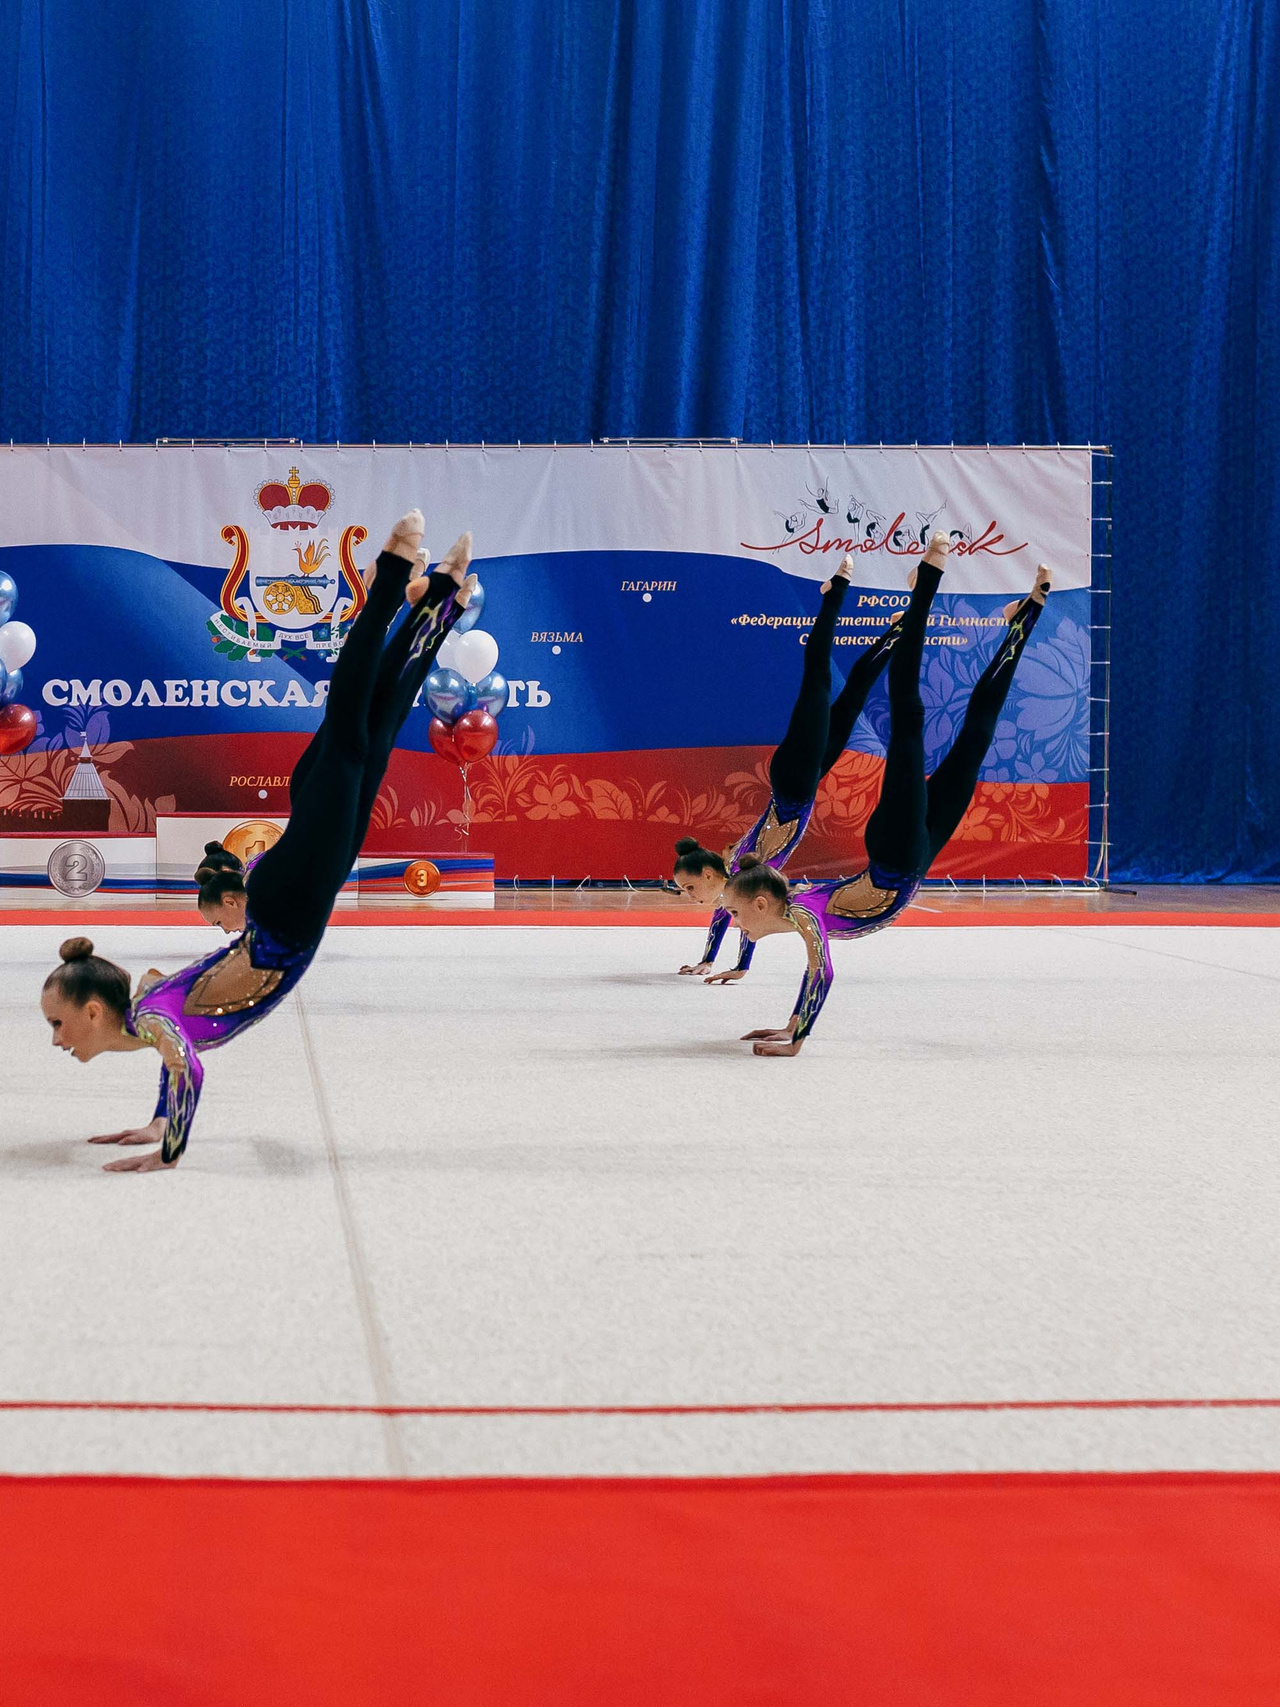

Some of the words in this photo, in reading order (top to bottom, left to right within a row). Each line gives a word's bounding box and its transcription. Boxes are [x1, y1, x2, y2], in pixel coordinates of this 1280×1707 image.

[740, 512, 1029, 557] Smolesk
[620, 580, 677, 592] ГАГАРИН
[857, 595, 911, 607] РФСОО
[939, 614, 1036, 627] Гимнаст
[530, 631, 584, 643] ВЯЗЬМА
[65, 853, 88, 882] 2
[416, 869, 428, 887] 3
